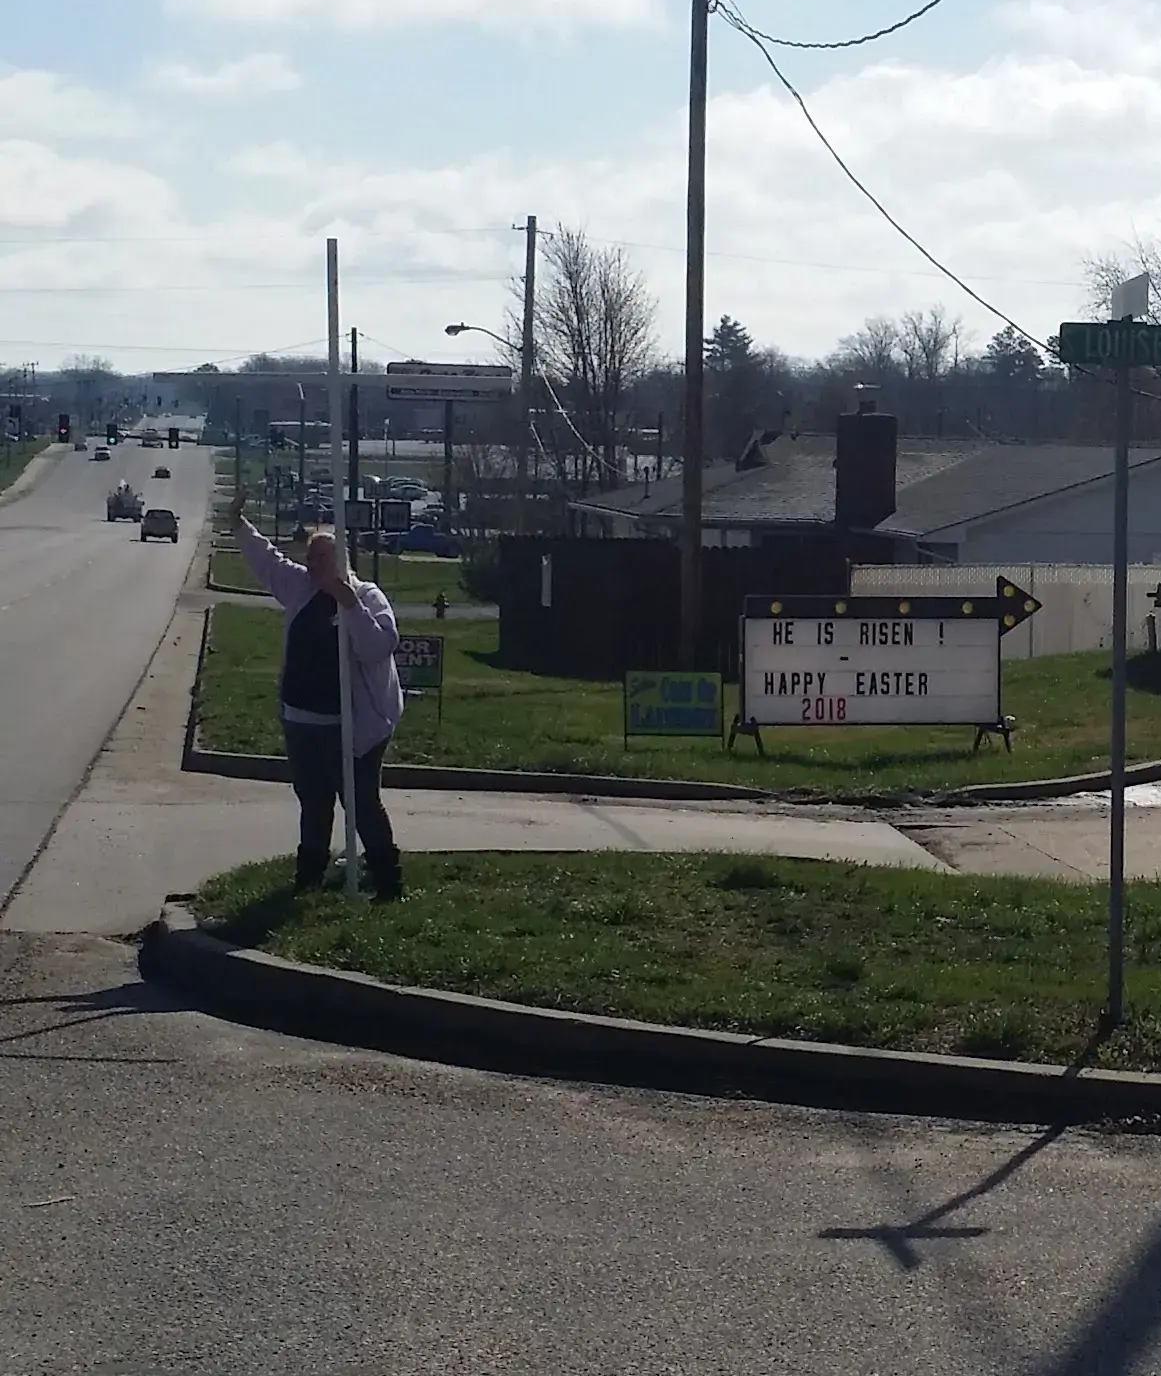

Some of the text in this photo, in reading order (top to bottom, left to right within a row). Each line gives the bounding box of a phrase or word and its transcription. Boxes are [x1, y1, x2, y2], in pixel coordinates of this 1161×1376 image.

[772, 621, 794, 646] HE
[816, 621, 835, 646] IS
[859, 622, 914, 646] RISEN
[400, 640, 429, 653] OR
[395, 653, 437, 666] ENT
[764, 672, 930, 696] HAPPY EASTER
[801, 697, 847, 721] 2018
